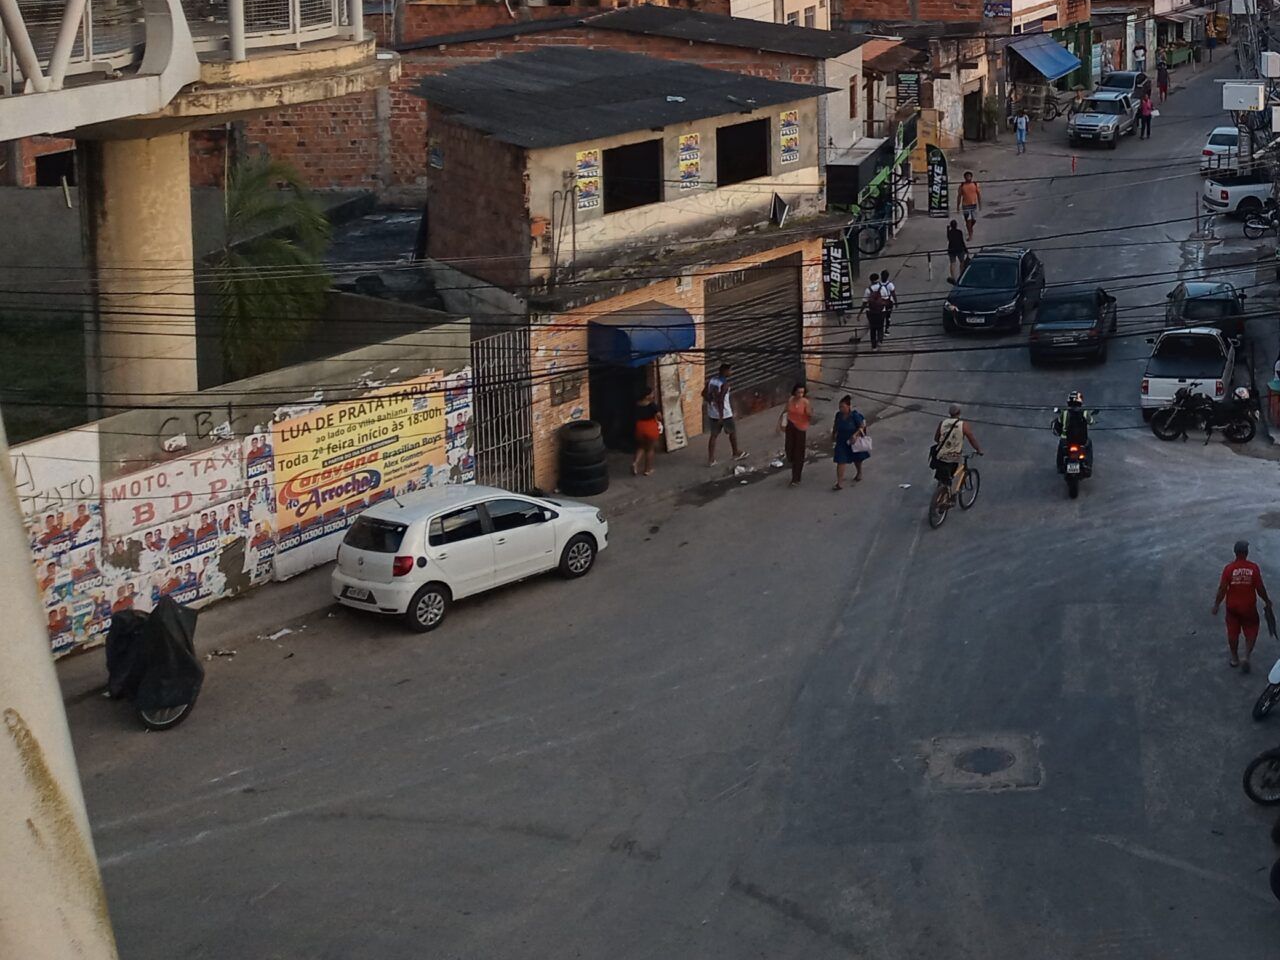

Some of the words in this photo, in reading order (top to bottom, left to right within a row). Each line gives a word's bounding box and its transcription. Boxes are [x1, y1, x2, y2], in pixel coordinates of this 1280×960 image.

[278, 454, 309, 471] Toda
[327, 437, 355, 454] feira
[406, 406, 442, 427] 18:00h
[281, 421, 312, 443] LUA
[315, 413, 335, 431] DE
[338, 396, 385, 424] PRATA
[315, 435, 326, 444] ao
[327, 428, 345, 440] lado
[346, 423, 357, 433] do
[377, 407, 408, 422] Bahiana
[111, 472, 168, 503] MOTO
